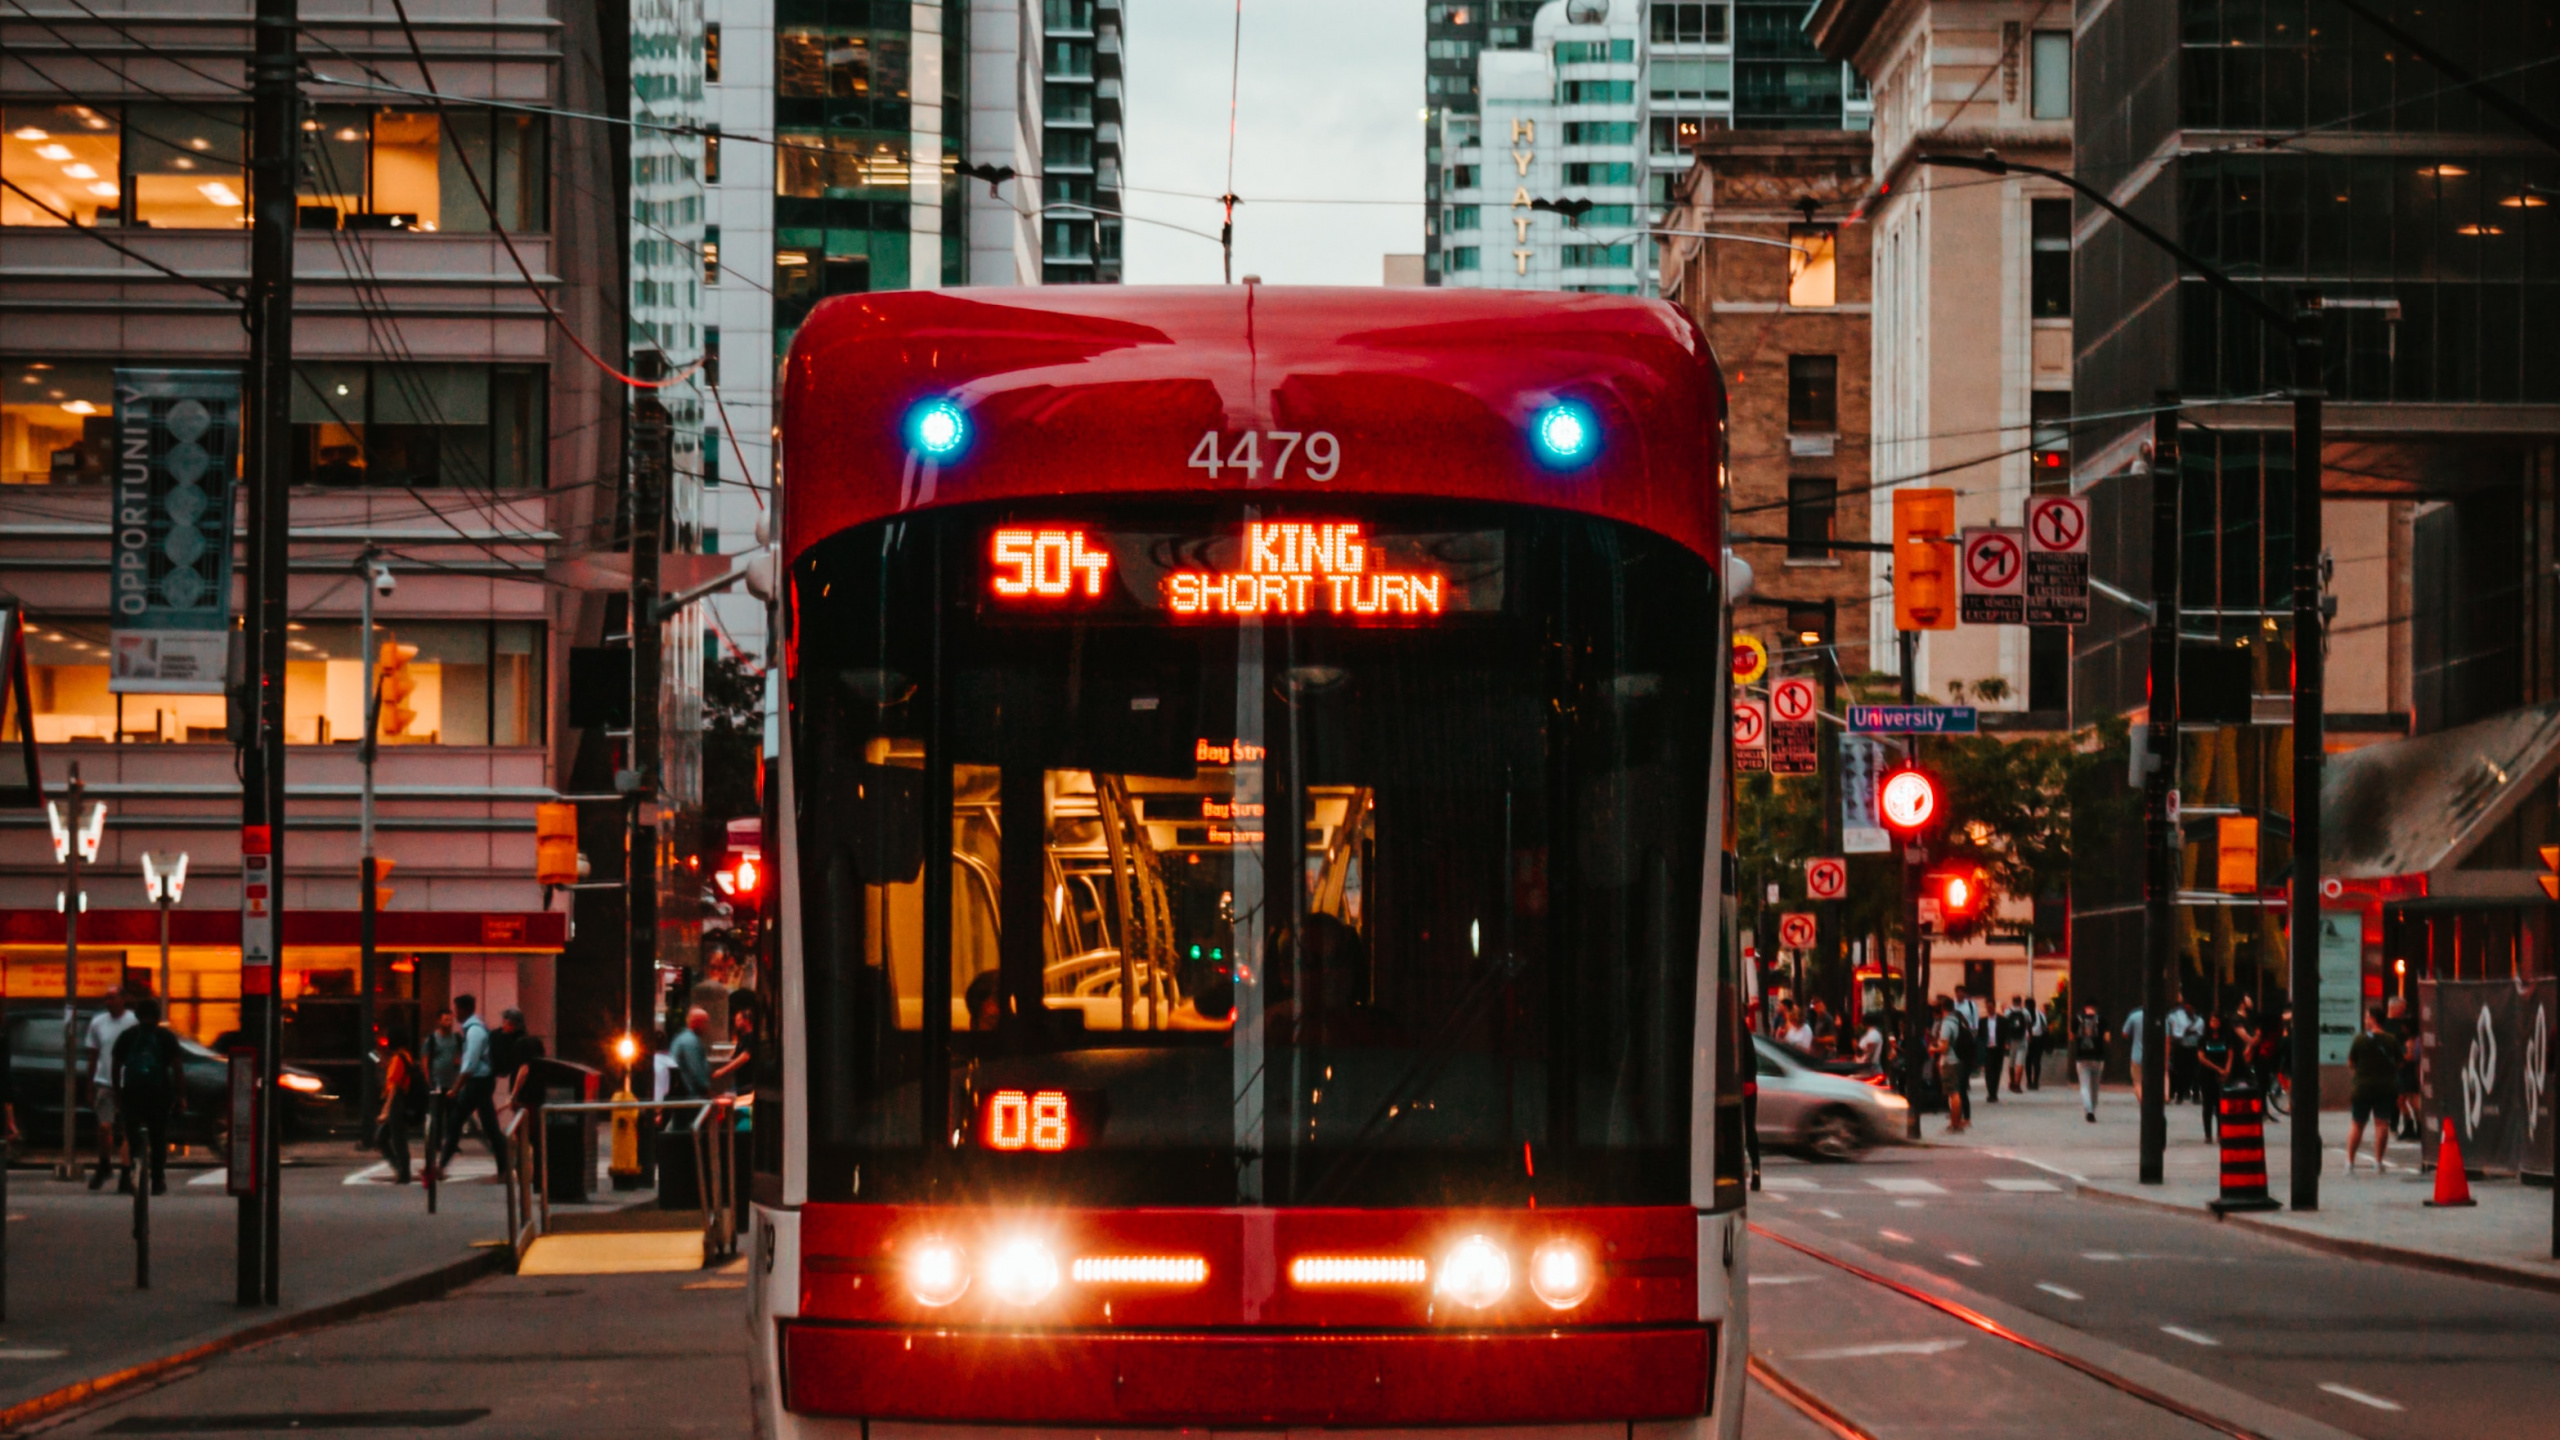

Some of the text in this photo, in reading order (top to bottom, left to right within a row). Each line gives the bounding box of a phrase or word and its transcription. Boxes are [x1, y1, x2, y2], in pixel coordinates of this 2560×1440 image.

[1511, 117, 1534, 275] HYATT
[1188, 431, 1340, 482] 4479
[119, 384, 149, 615] OPPORTUNITY
[993, 523, 1364, 595] 504 KING
[1170, 574, 1440, 613] SHORT TURN
[1965, 609, 2020, 620] EXCEPTED
[1854, 708, 1969, 731] University Ave
[1196, 738, 1231, 764] Bay
[1203, 797, 1230, 818] Bay
[993, 1090, 1067, 1149] 08
